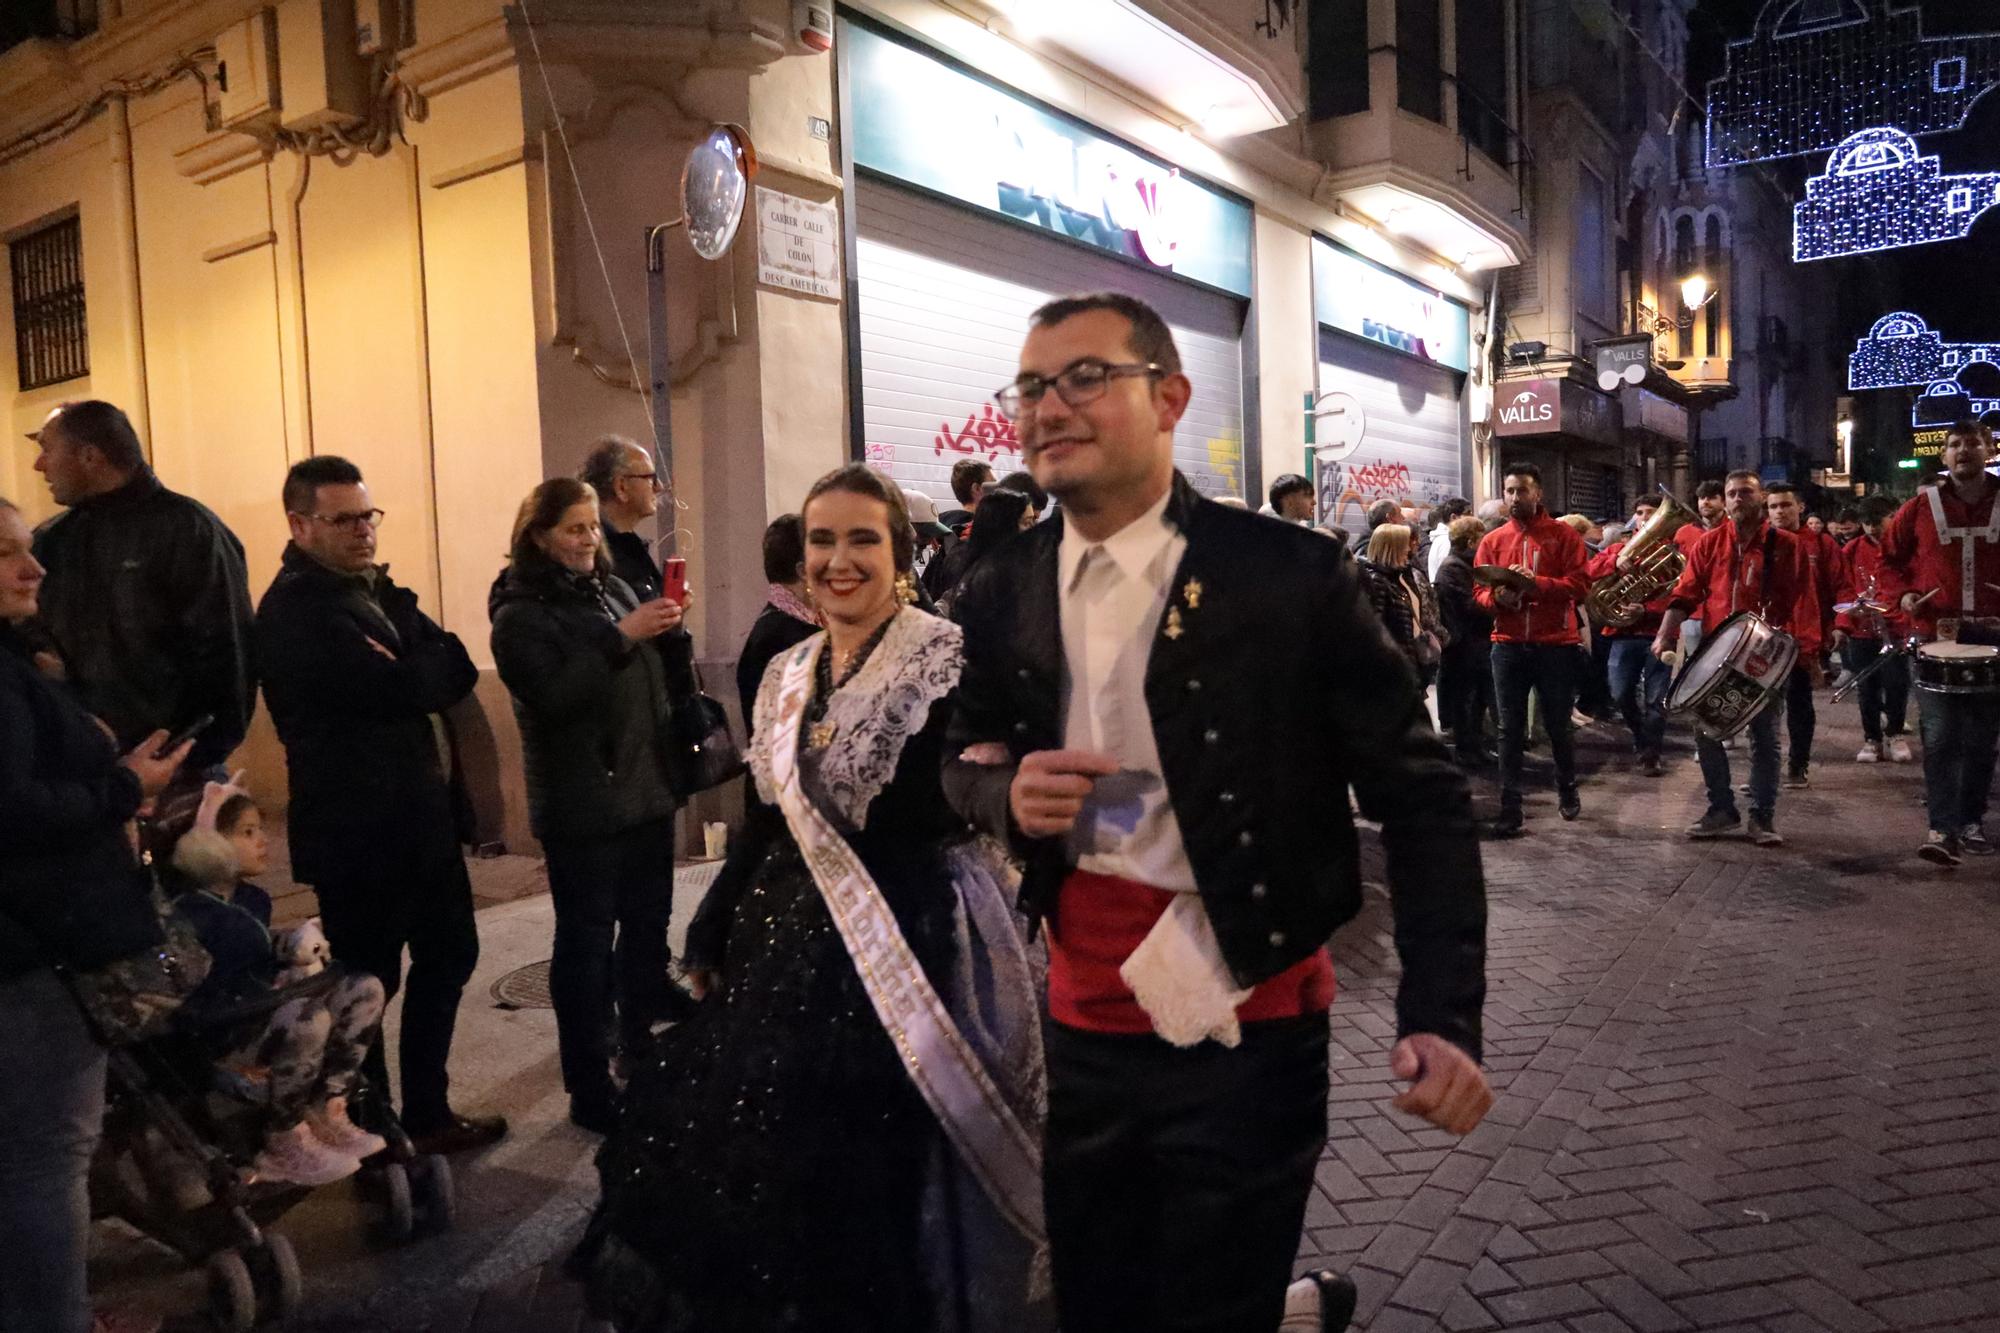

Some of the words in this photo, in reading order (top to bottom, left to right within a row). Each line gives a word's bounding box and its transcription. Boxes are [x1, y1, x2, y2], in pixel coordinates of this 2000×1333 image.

[815, 120, 827, 137] 49
[771, 212, 798, 227] CARRER
[803, 220, 824, 234] CALLE
[794, 235, 805, 248] DE
[790, 278, 830, 295] AMERICAS
[1613, 350, 1645, 361] VALLS
[1499, 404, 1552, 424] VALLS
